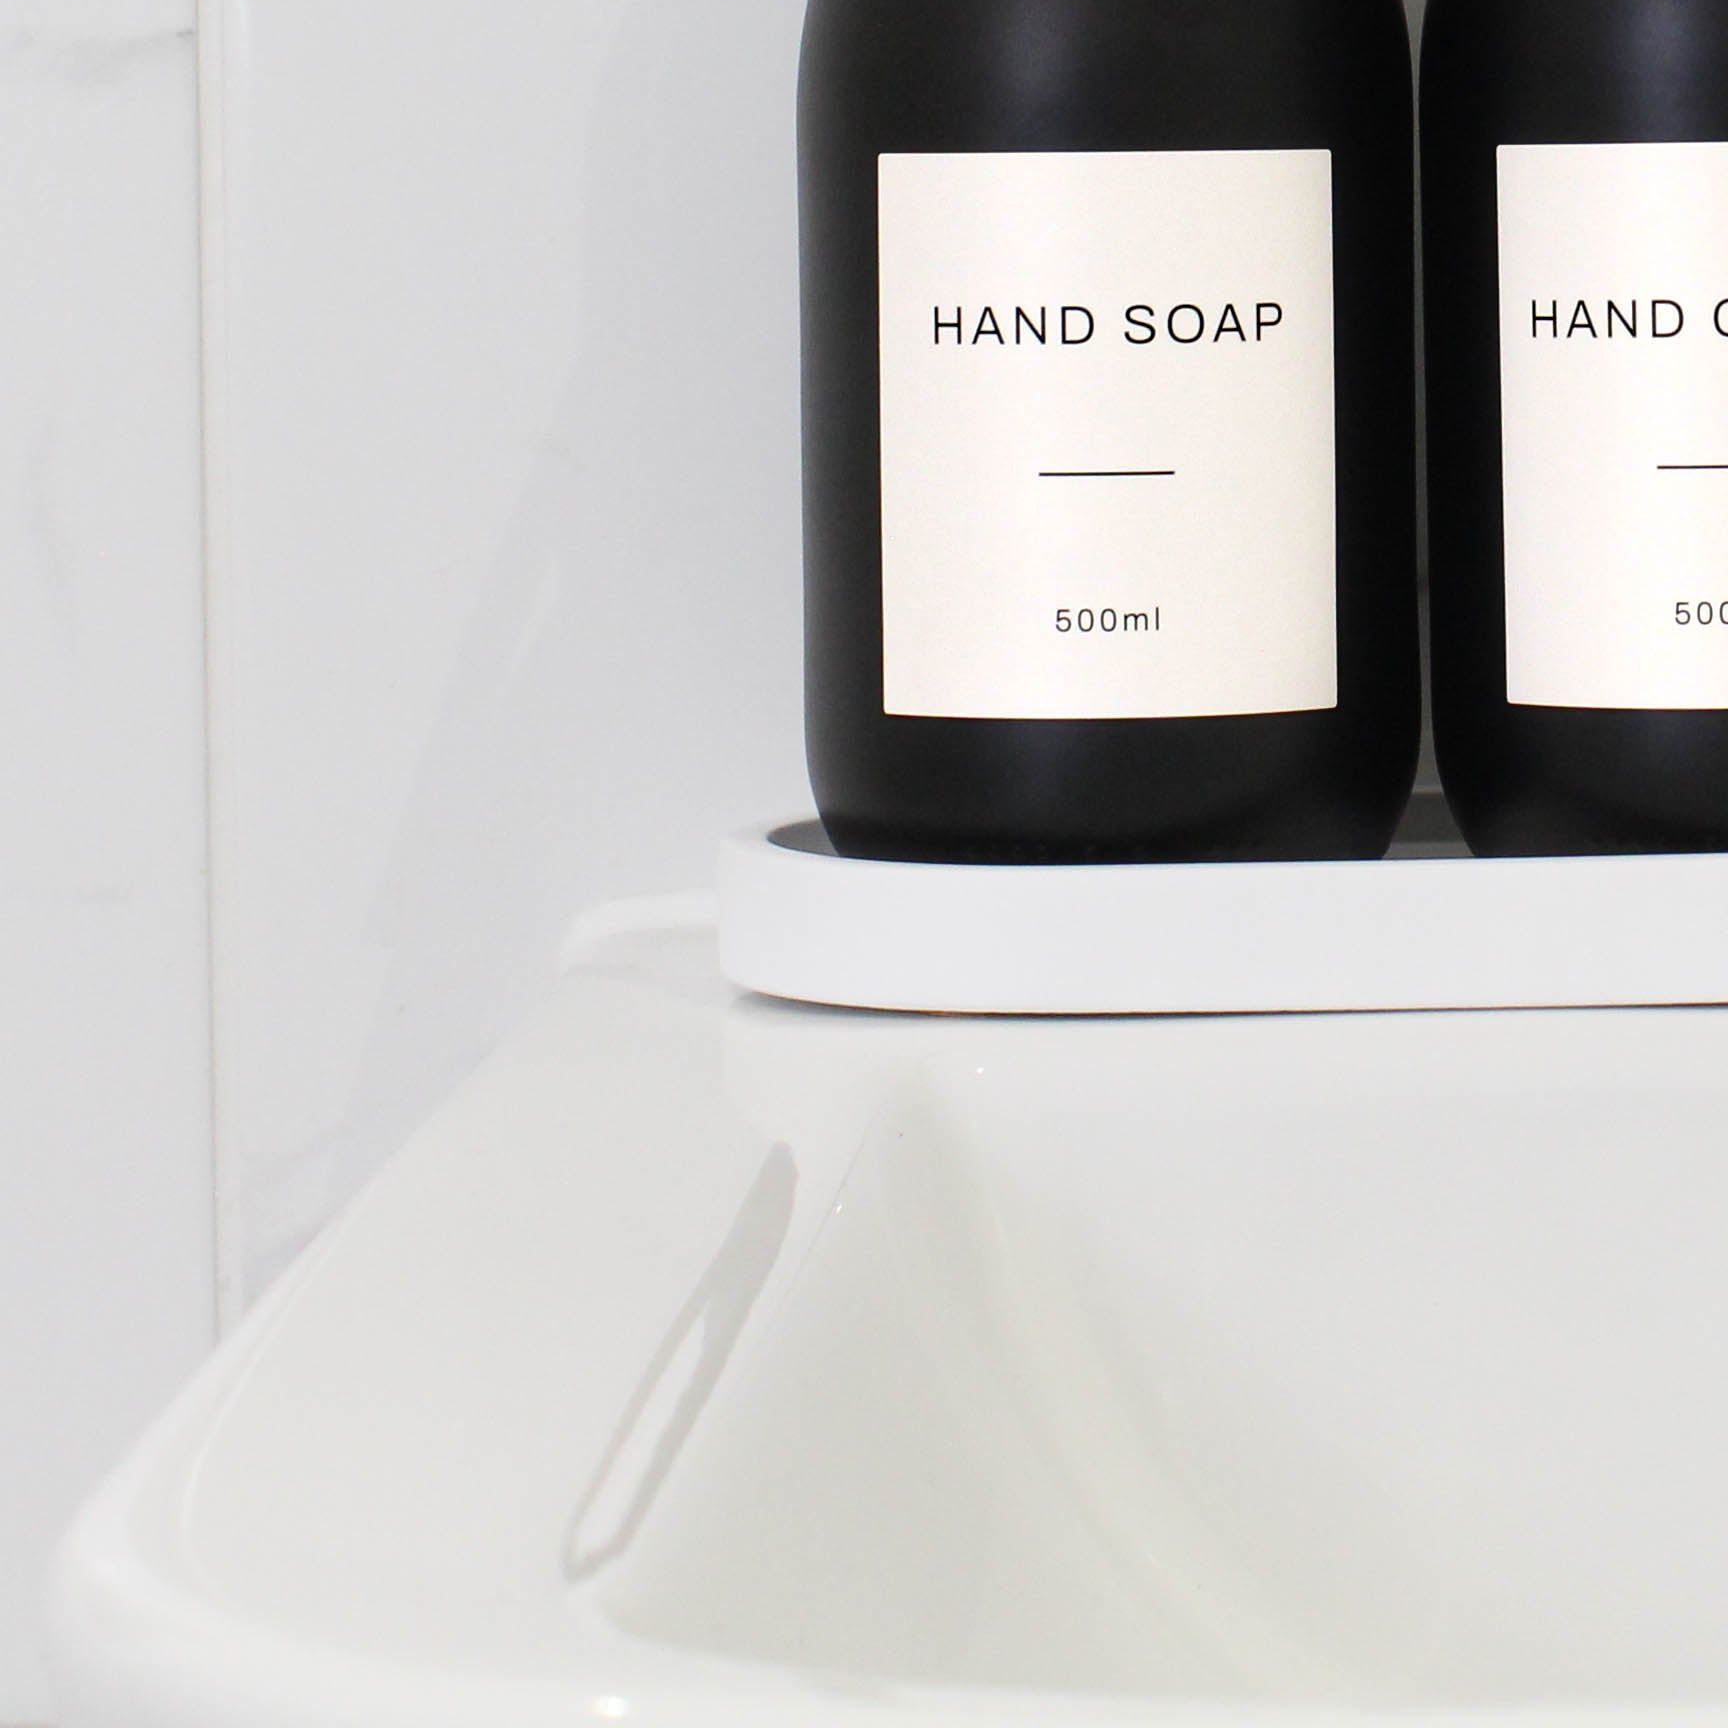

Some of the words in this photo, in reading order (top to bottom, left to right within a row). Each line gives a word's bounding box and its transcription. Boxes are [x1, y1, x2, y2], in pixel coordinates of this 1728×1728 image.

[932, 304, 1095, 345] HAND
[1123, 302, 1283, 345] SOAP
[1530, 298, 1684, 339] HAND
[1054, 606, 1160, 633] 500ml
